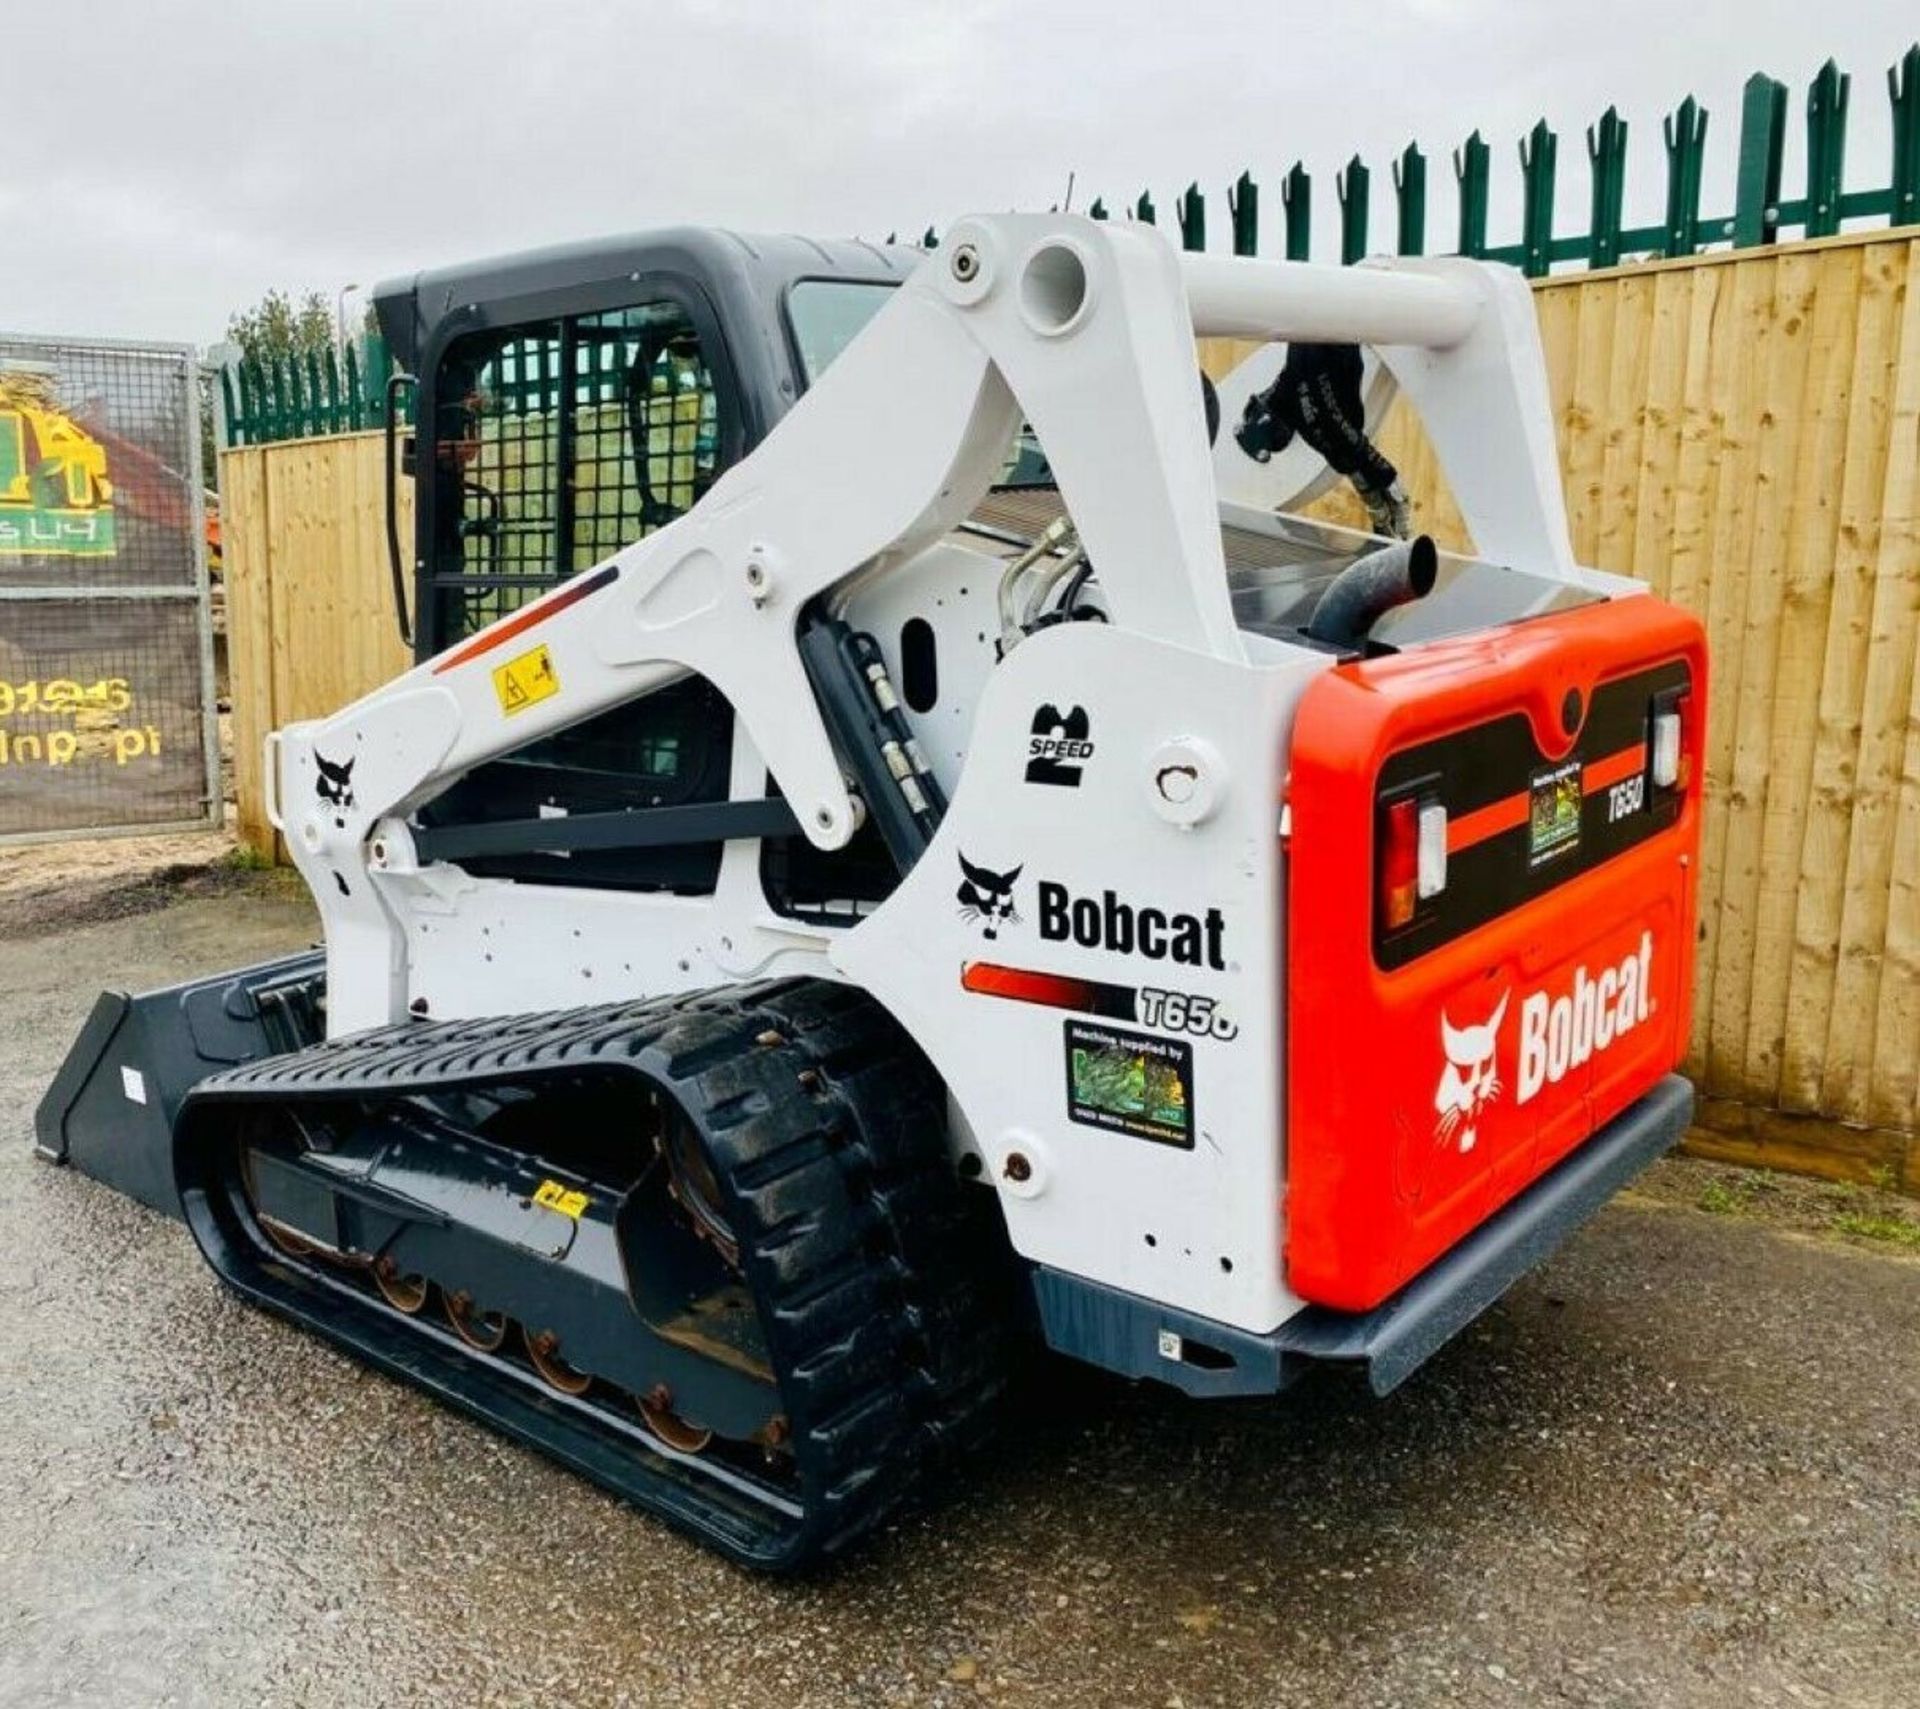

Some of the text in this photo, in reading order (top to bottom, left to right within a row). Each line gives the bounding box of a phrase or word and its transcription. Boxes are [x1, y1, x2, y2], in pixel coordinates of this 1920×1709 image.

[1029, 738, 1095, 760] SPEED
[1609, 775, 1644, 823] T650
[1038, 880, 1226, 972] Bobcat
[1072, 1027, 1117, 1045] Machine
[1120, 1037, 1166, 1054] supplied
[1517, 930, 1653, 1105] Bobcat
